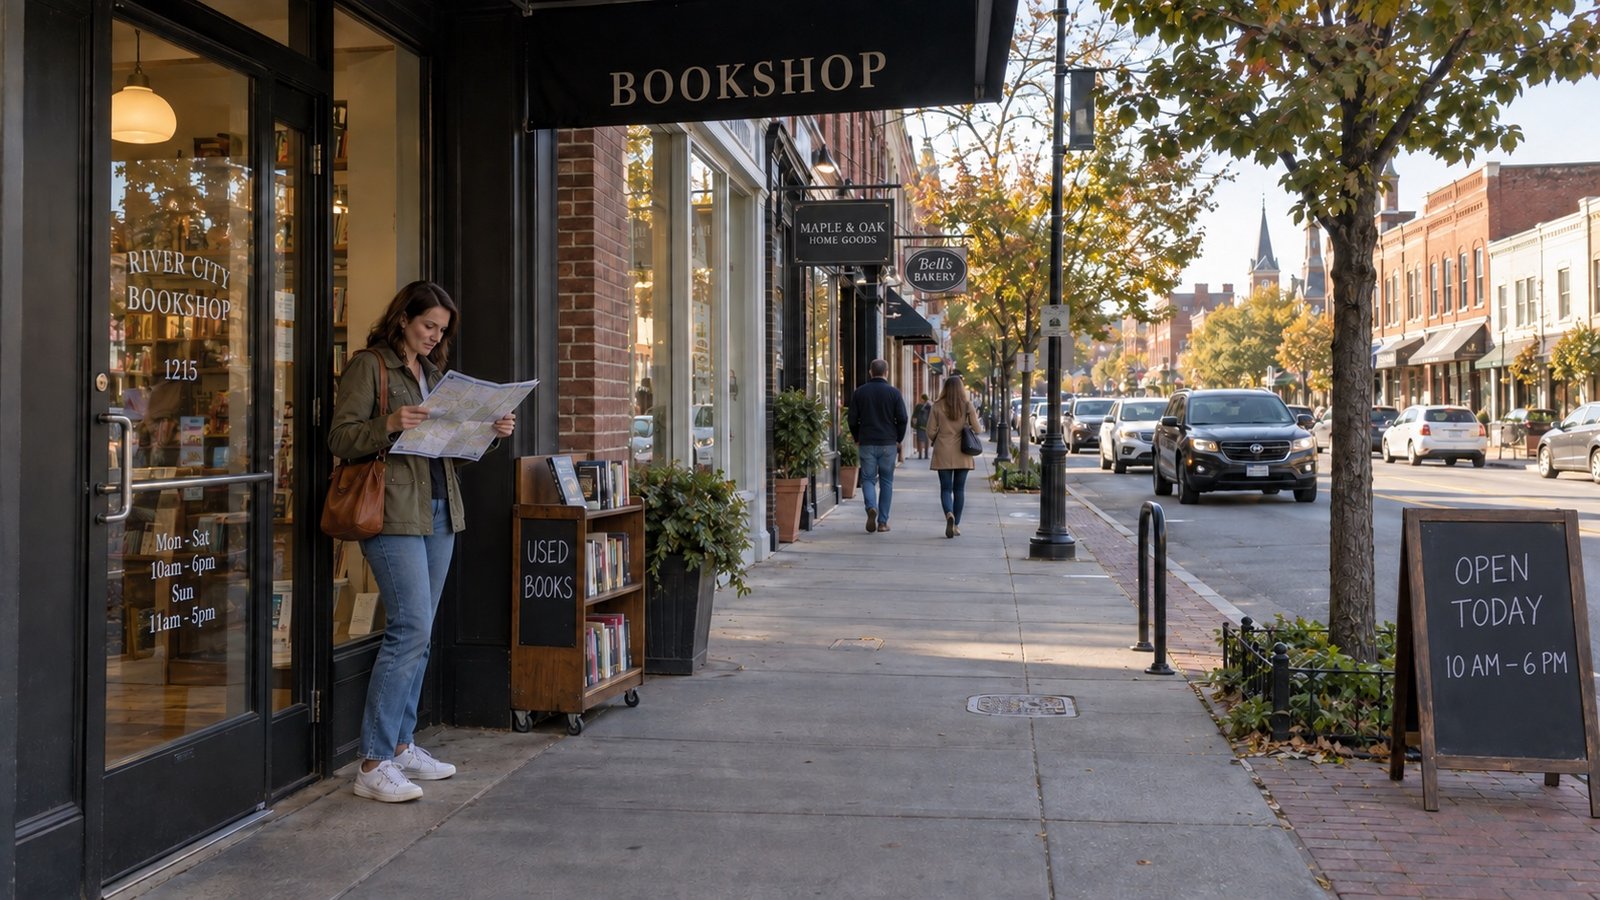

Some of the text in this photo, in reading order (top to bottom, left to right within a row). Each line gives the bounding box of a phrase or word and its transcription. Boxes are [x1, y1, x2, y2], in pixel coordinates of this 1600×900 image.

[609, 51, 887, 107] BOOKSHOP
[800, 221, 885, 233] MAPLE & OAK
[809, 235, 877, 245] HOME GOODS
[127, 249, 231, 289] RIVER CITY
[918, 257, 953, 271] Bell's
[914, 272, 956, 282] BAKERY
[127, 285, 231, 321] BOOKSHOP
[164, 358, 198, 381] 1215
[155, 532, 182, 552] Mon
[192, 529, 210, 548] Sat
[527, 539, 569, 564] USED
[151, 560, 182, 580] 10am
[192, 554, 216, 577] 6pm
[1455, 552, 1529, 585] OPEN
[172, 583, 194, 603] Sun
[524, 575, 573, 599] BOOKS
[150, 613, 181, 634] 11am
[191, 605, 216, 627] 5pm
[1451, 594, 1543, 628] TODAY
[1446, 655, 1465, 679] 10
[1471, 653, 1500, 677] AM
[1523, 651, 1536, 676] 6
[1542, 651, 1568, 674] PM
